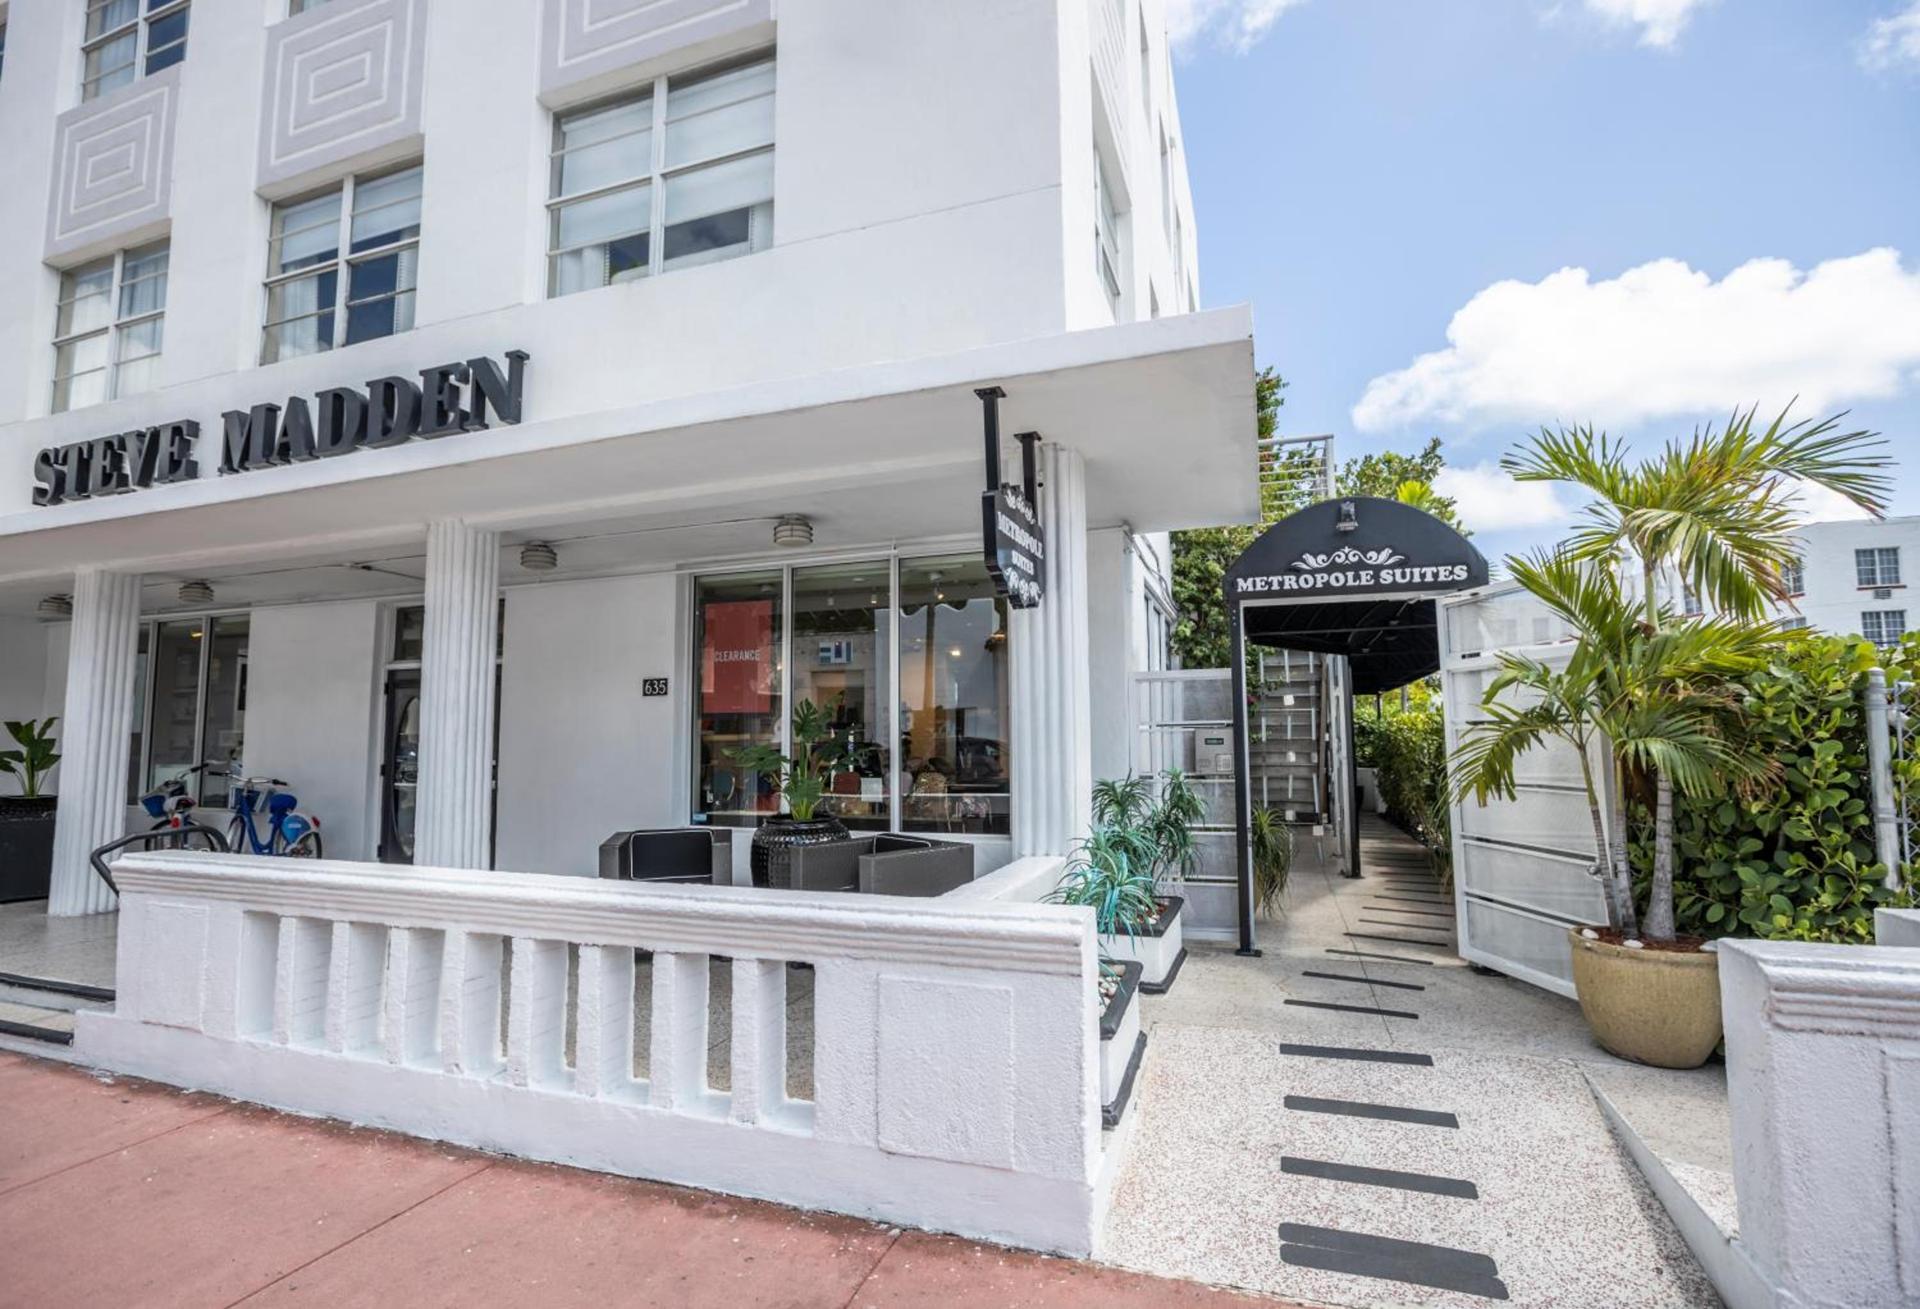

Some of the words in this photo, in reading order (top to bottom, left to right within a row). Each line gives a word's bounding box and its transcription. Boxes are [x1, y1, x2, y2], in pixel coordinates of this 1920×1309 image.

[32, 419, 201, 505] STEVE
[218, 350, 530, 475] MADDEN
[1236, 570, 1375, 593] METROPOLE
[1379, 564, 1469, 586] SUITES
[714, 649, 760, 662] CLEARANCE
[645, 680, 666, 694] 635
